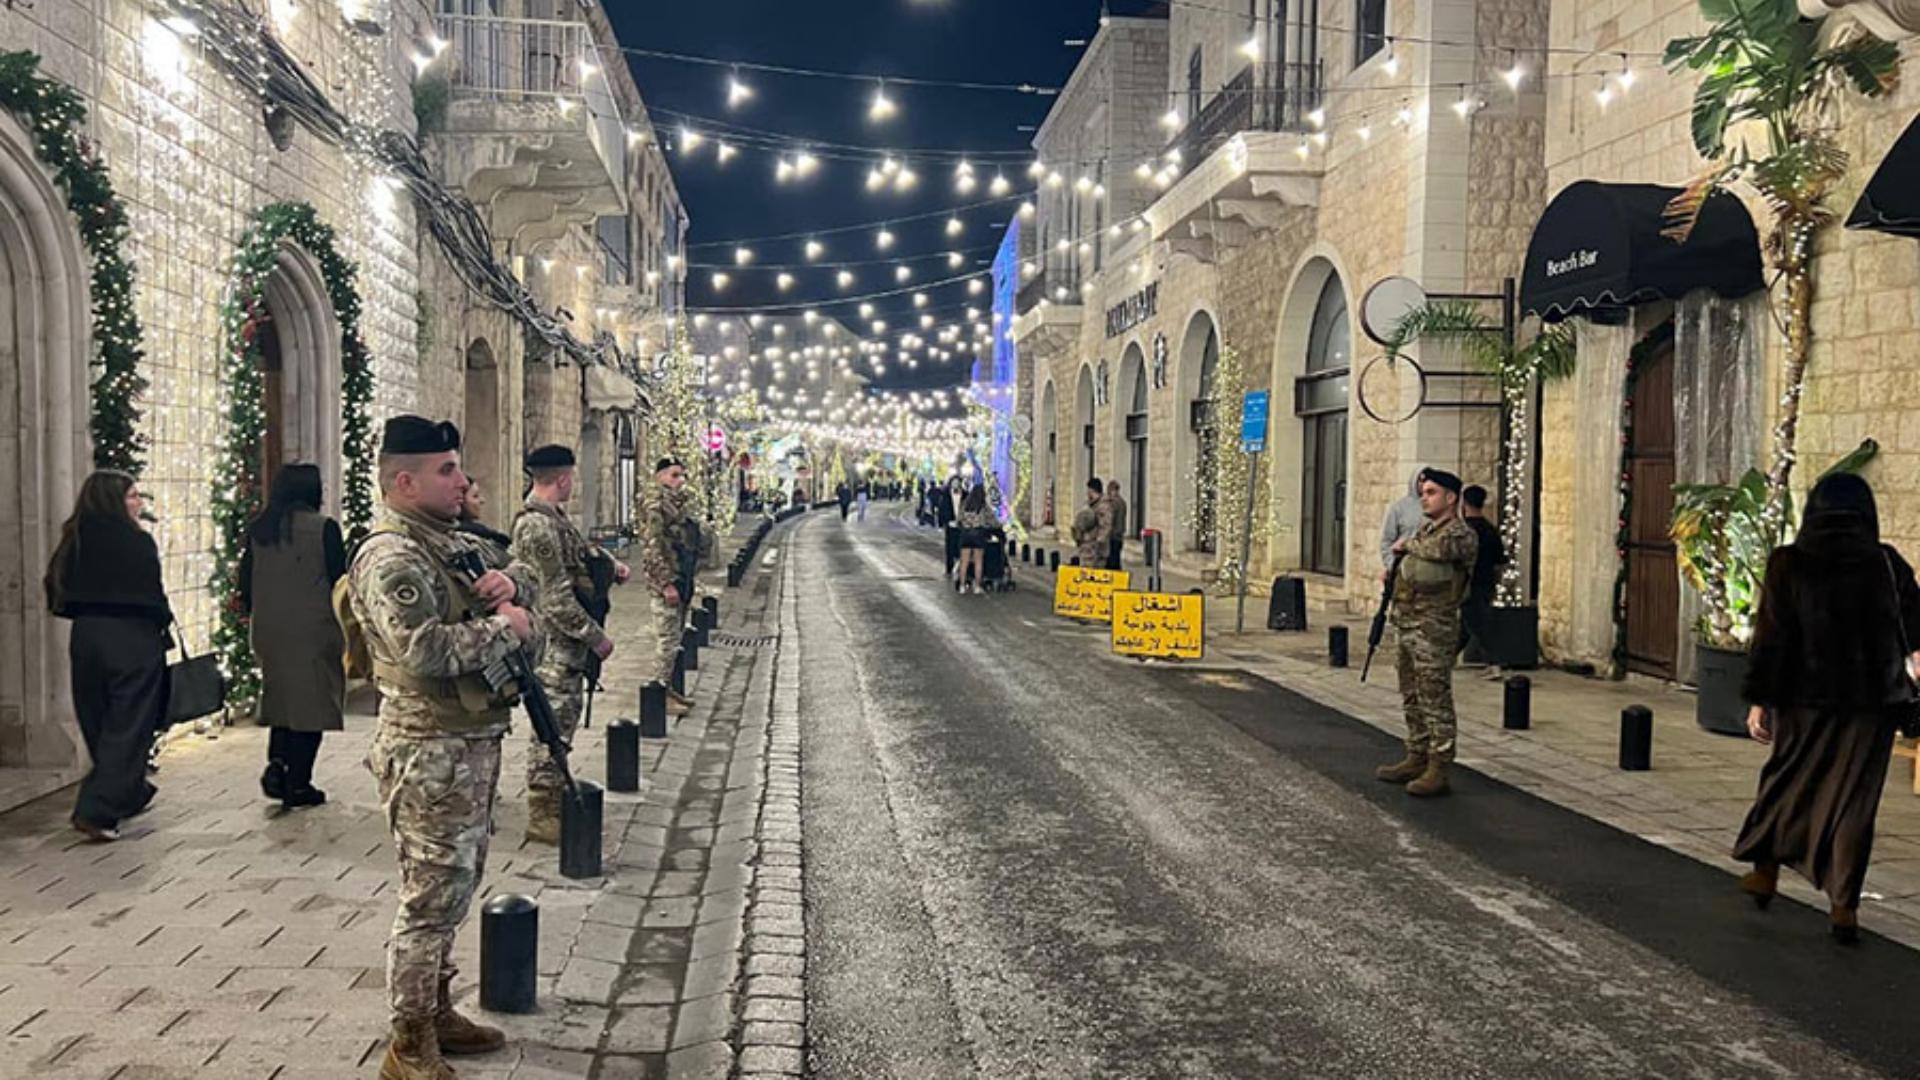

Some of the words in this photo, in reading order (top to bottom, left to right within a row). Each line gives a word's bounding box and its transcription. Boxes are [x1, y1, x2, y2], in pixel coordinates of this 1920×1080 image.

[1546, 251, 1577, 276] Beach
[1580, 249, 1598, 267] Bar
[1123, 614, 1156, 632] جونية
[1162, 616, 1191, 633] بلدية
